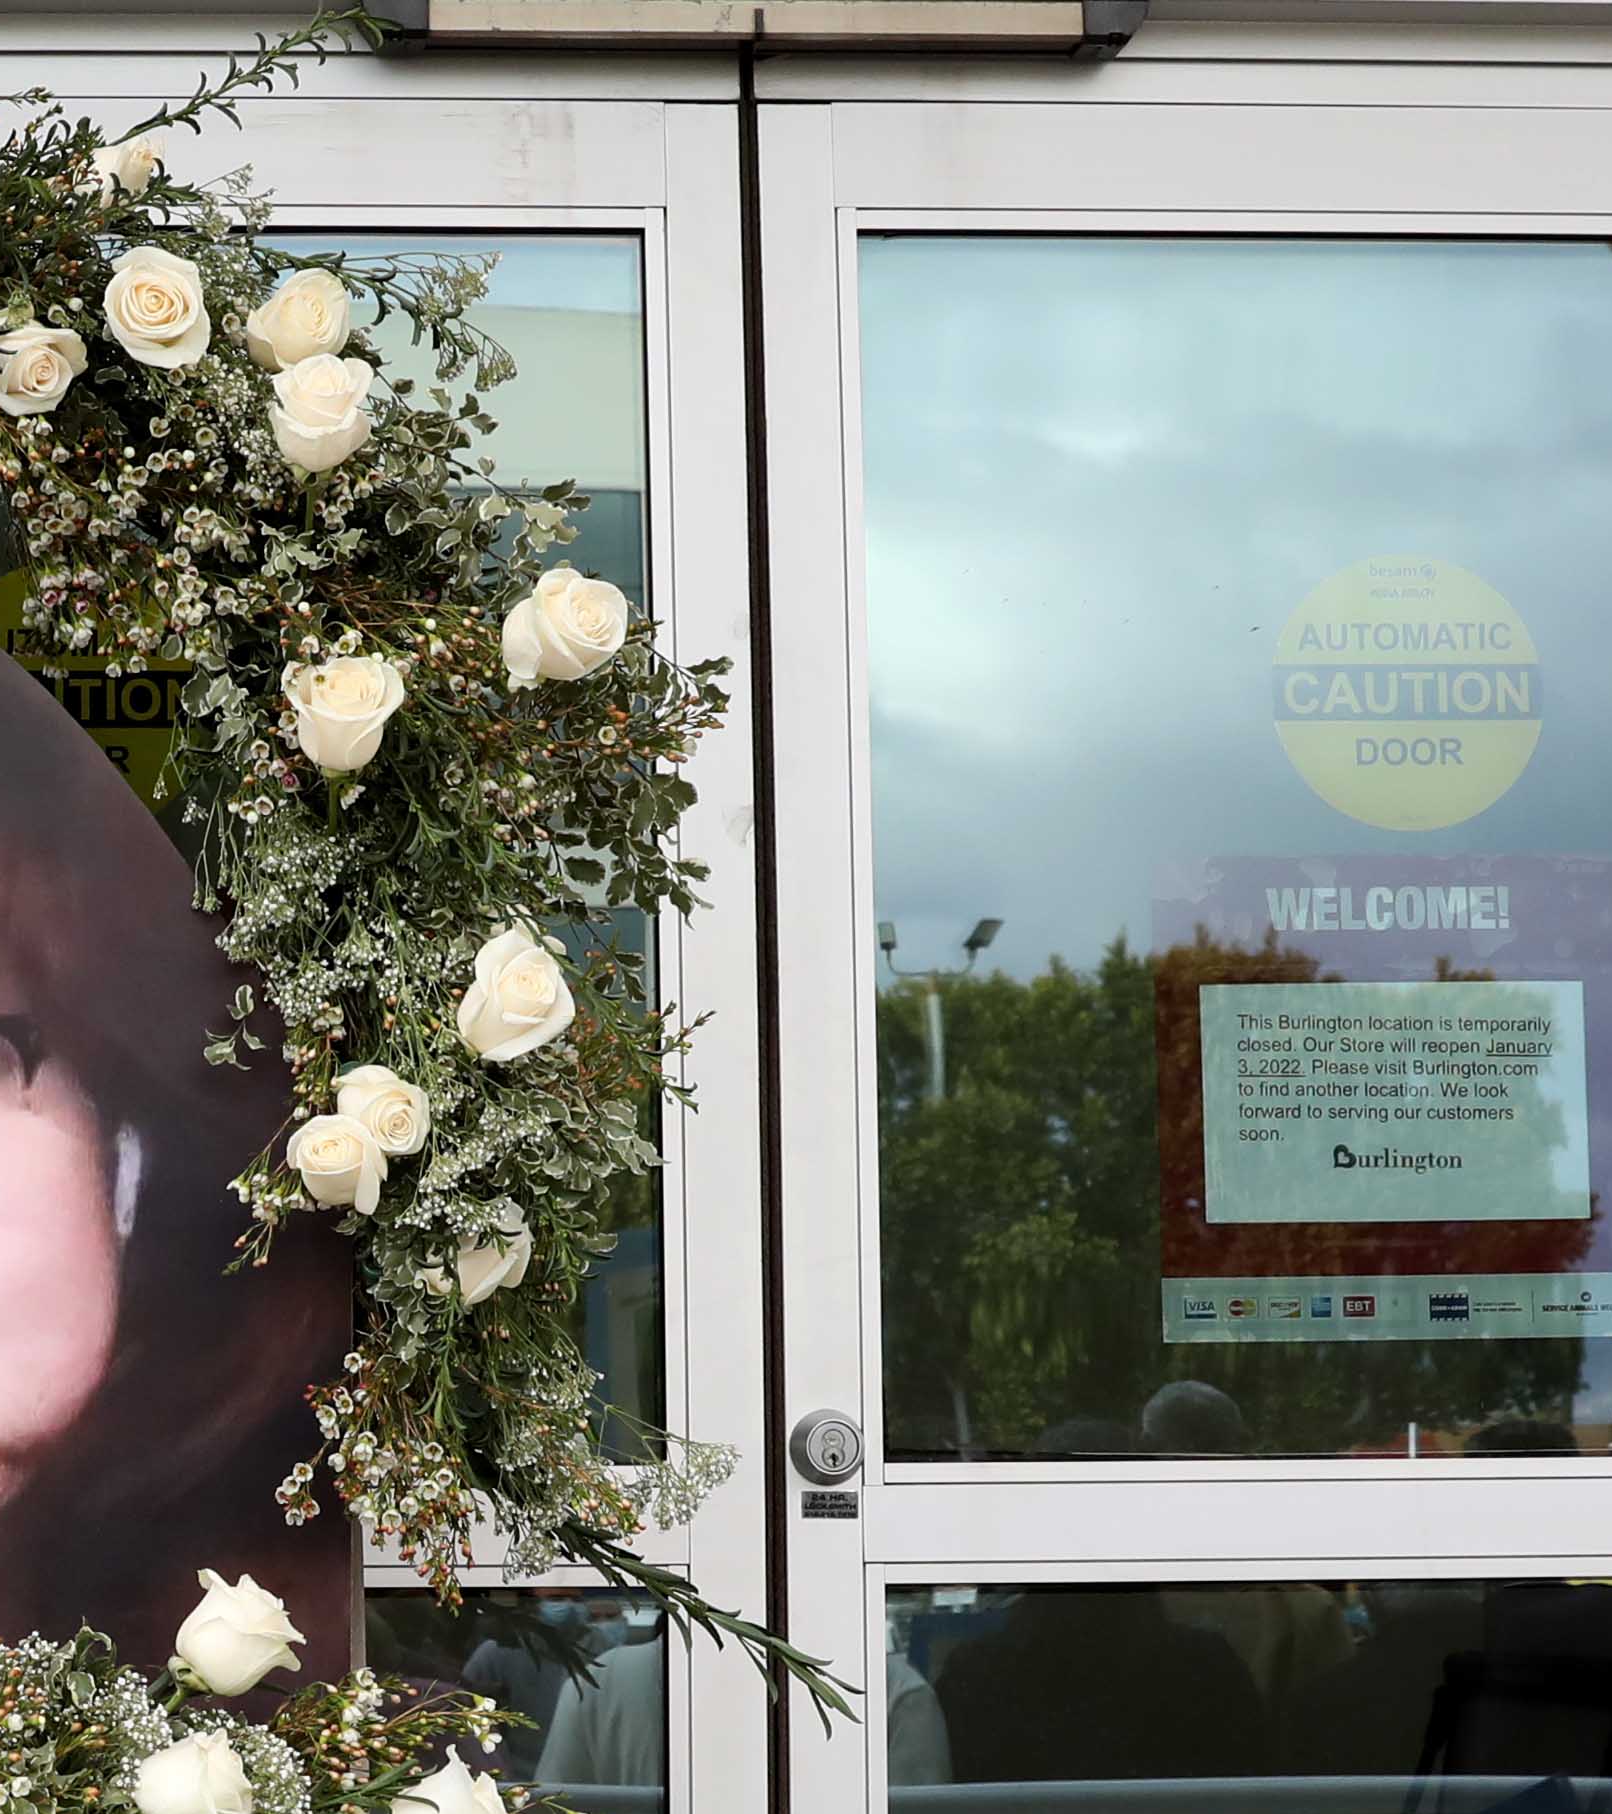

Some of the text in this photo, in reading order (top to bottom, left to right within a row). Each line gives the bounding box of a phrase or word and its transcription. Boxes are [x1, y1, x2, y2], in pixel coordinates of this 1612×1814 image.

[1298, 622, 1512, 652] AUTOMATIC
[1283, 670, 1532, 715] CAUTION
[1355, 737, 1465, 767] DOOR
[1264, 883, 1511, 932] WELCOME!
[1237, 1014, 1551, 1035] This Burlington location is temporarily
[1237, 1037, 1552, 1059] closed. Our Store will reopen January
[1237, 1059, 1538, 1080] 3, 2022. Please visit Burlington.com
[1238, 1081, 1509, 1099] to find another location. We look
[1238, 1103, 1514, 1123] forward to serving our customers
[1238, 1128, 1285, 1143] soon.
[1332, 1144, 1463, 1174] Burlington
[1187, 1301, 1216, 1312] VISA
[1345, 1300, 1371, 1313] EBT
